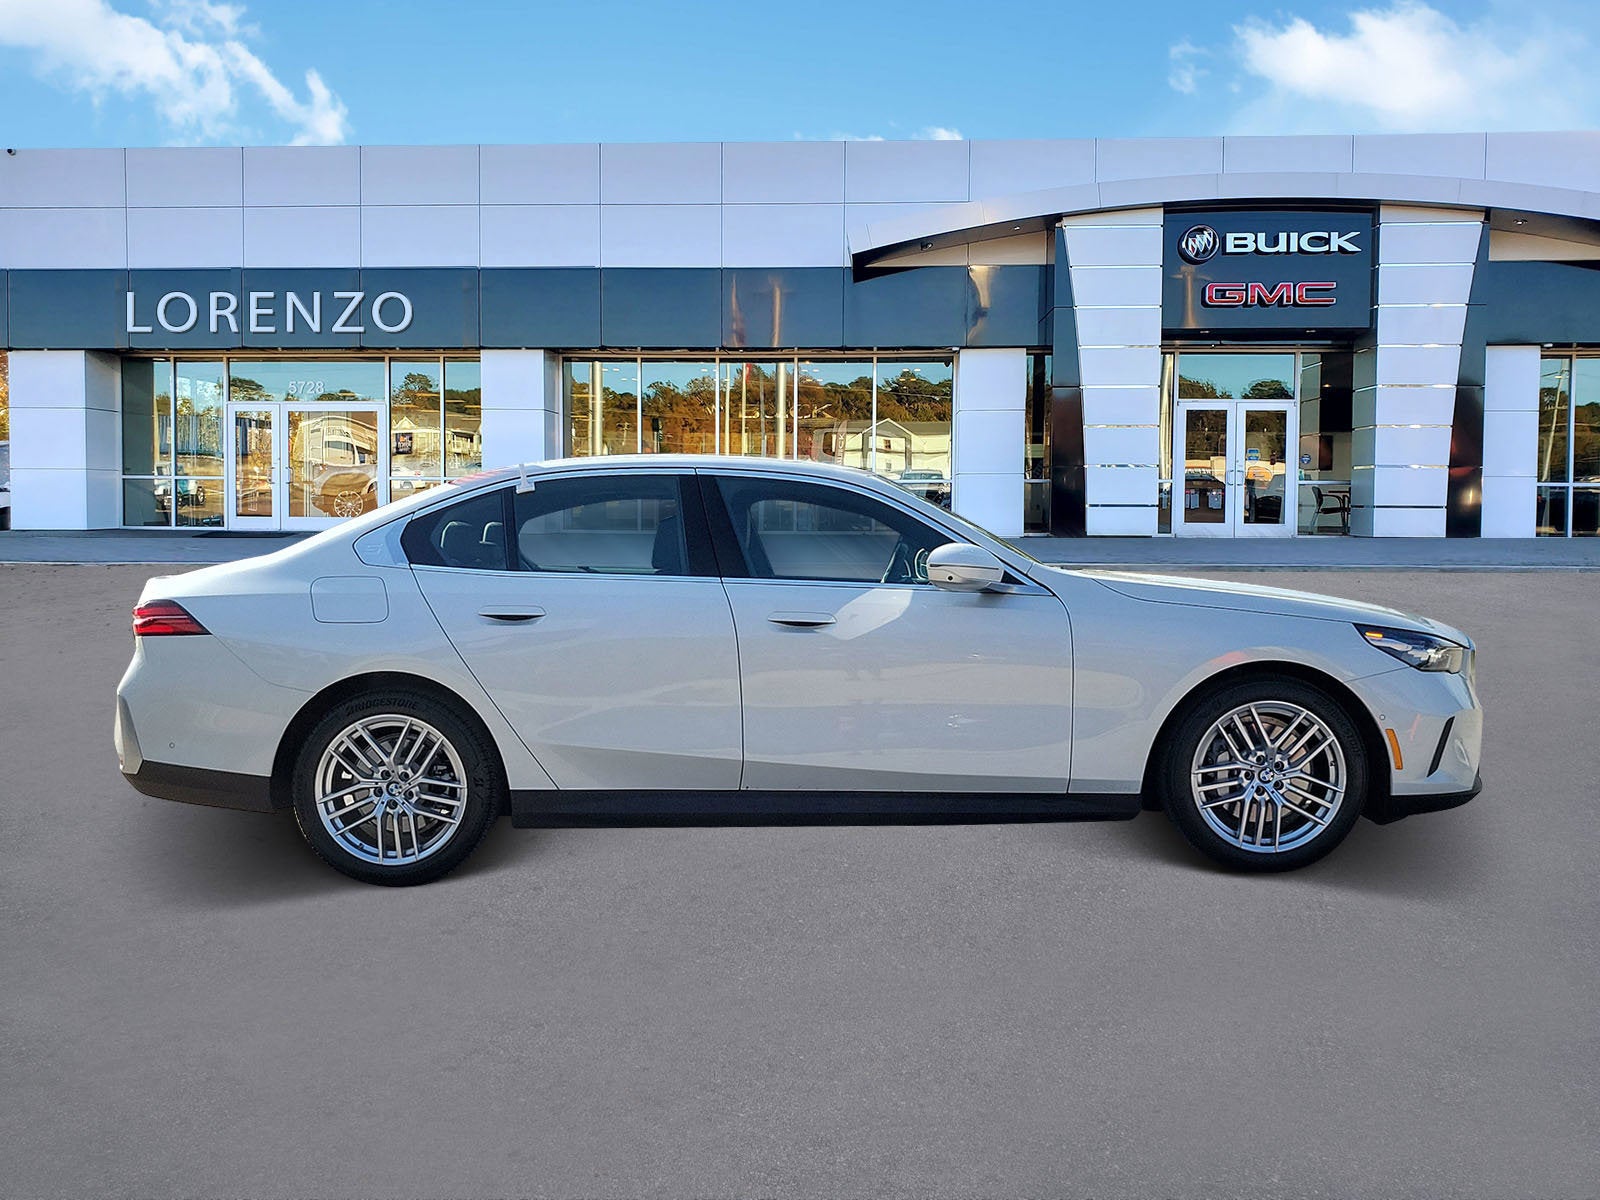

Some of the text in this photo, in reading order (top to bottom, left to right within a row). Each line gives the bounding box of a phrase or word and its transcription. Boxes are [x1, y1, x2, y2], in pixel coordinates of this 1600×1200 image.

[1225, 231, 1362, 253] BUICK
[1205, 281, 1337, 306] GMC
[126, 291, 414, 333] LORENZO
[288, 380, 325, 394] 5728
